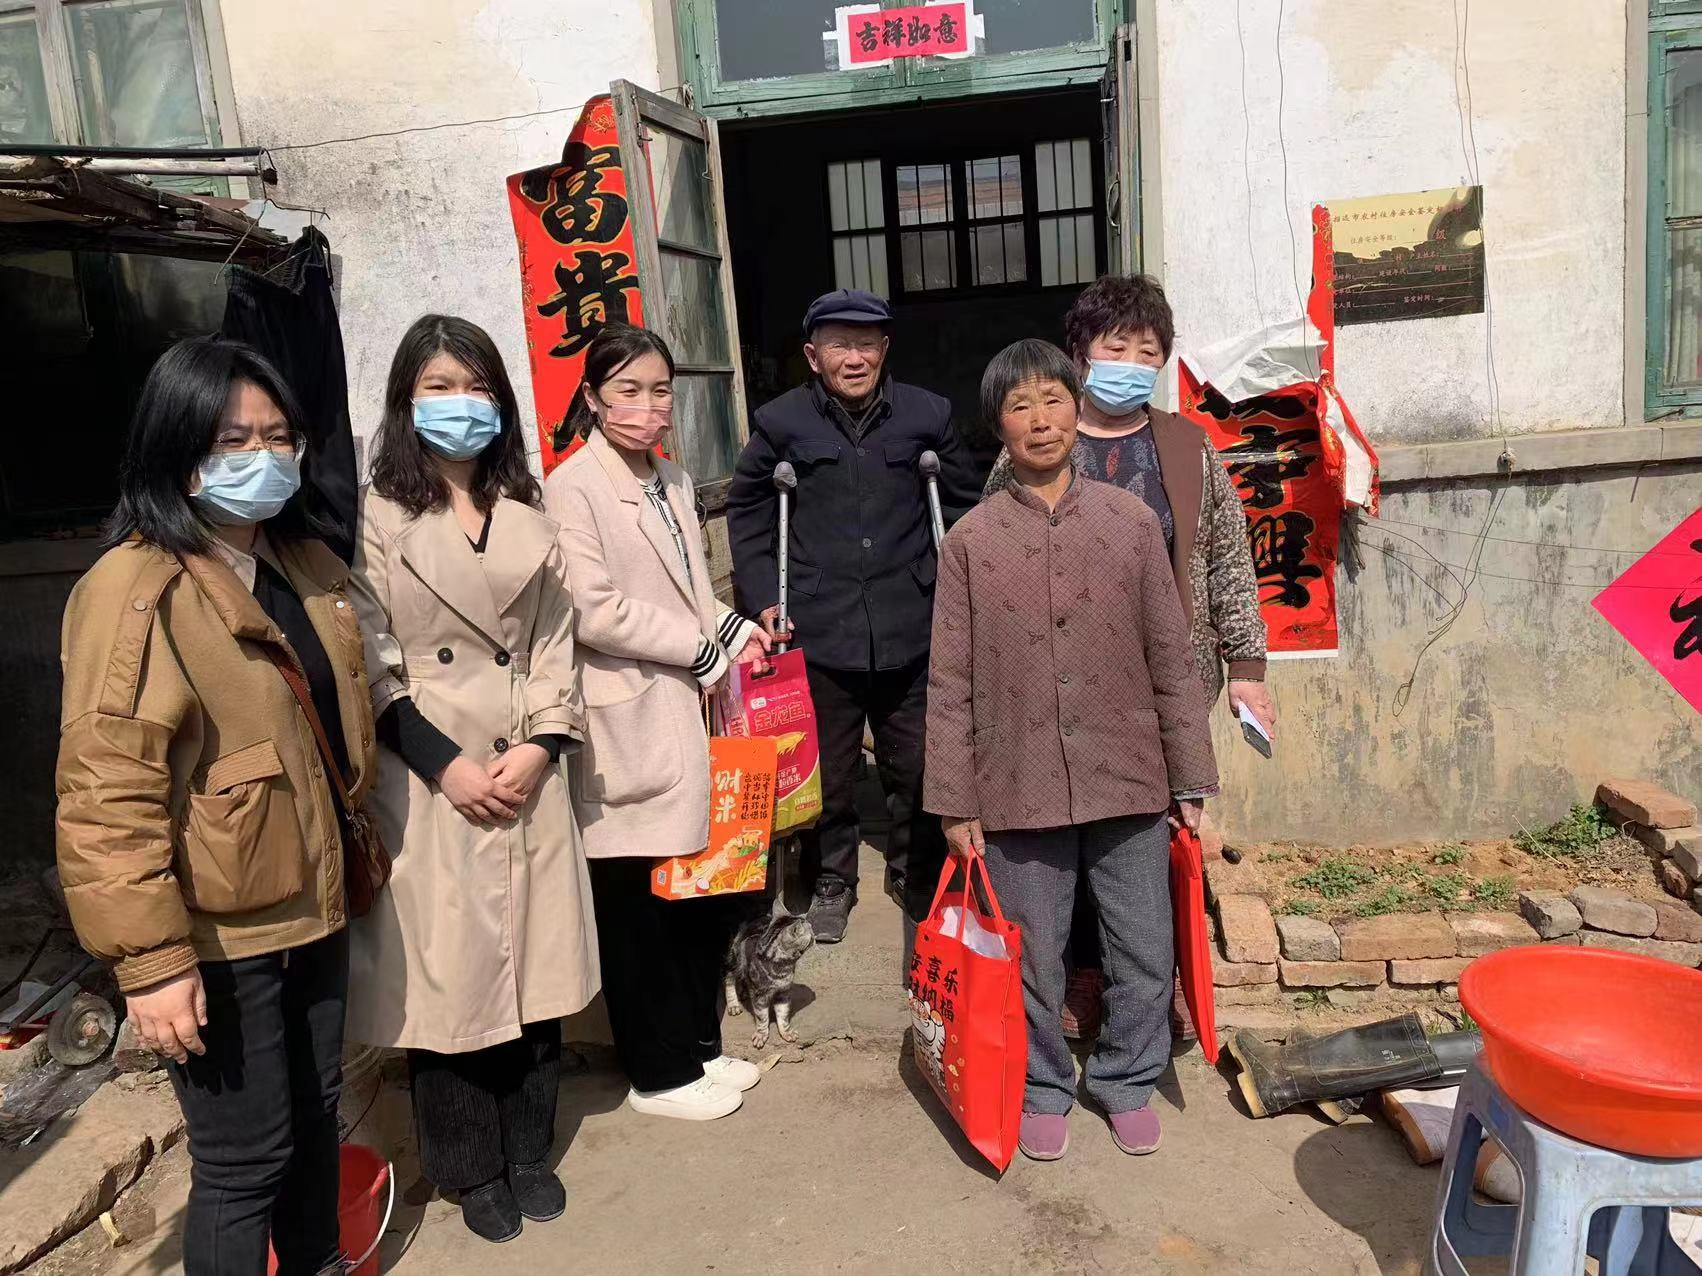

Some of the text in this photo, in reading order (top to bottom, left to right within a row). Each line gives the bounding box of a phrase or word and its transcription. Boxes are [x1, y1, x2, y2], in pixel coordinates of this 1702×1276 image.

[856, 13, 958, 52] 吉祥如意
[754, 701, 806, 733] 金龙鱼
